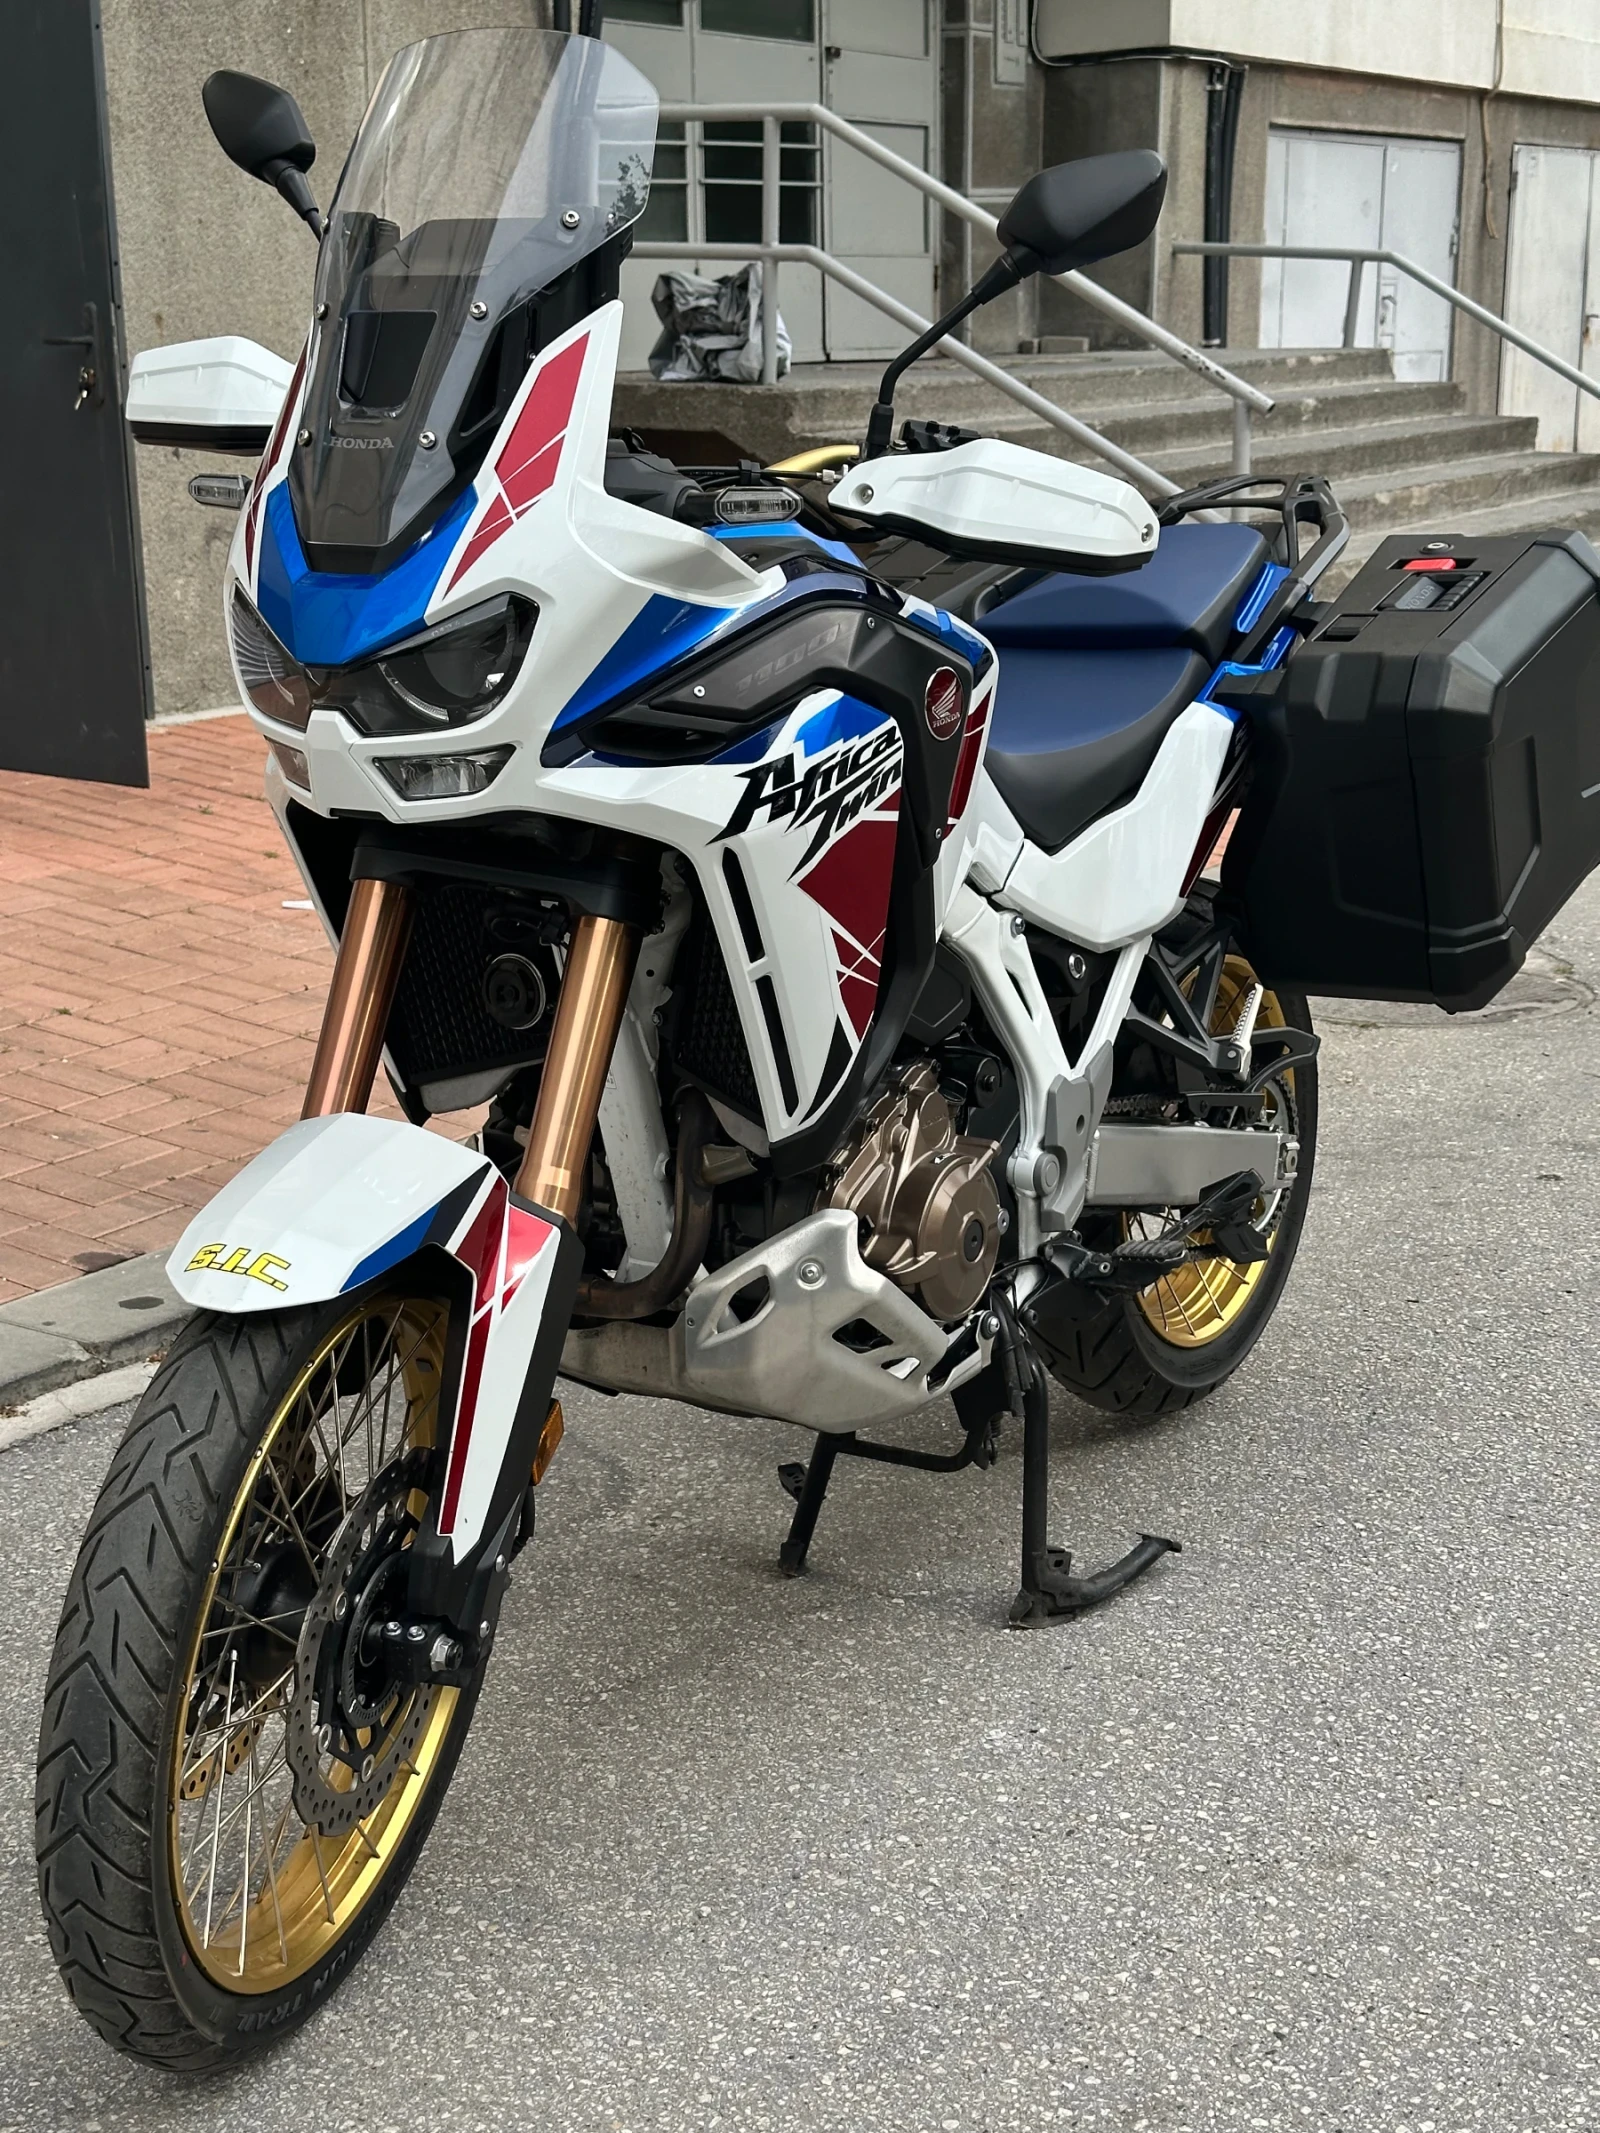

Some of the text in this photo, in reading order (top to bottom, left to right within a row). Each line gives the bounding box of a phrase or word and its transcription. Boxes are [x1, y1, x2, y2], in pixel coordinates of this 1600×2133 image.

[329, 436, 394, 449] HONDA
[932, 711, 961, 728] HONDA
[705, 725, 903, 846] Africa
[784, 744, 903, 883] Twin
[184, 1243, 292, 1292] S.I.C.
[237, 1994, 301, 2033] TRAIL
